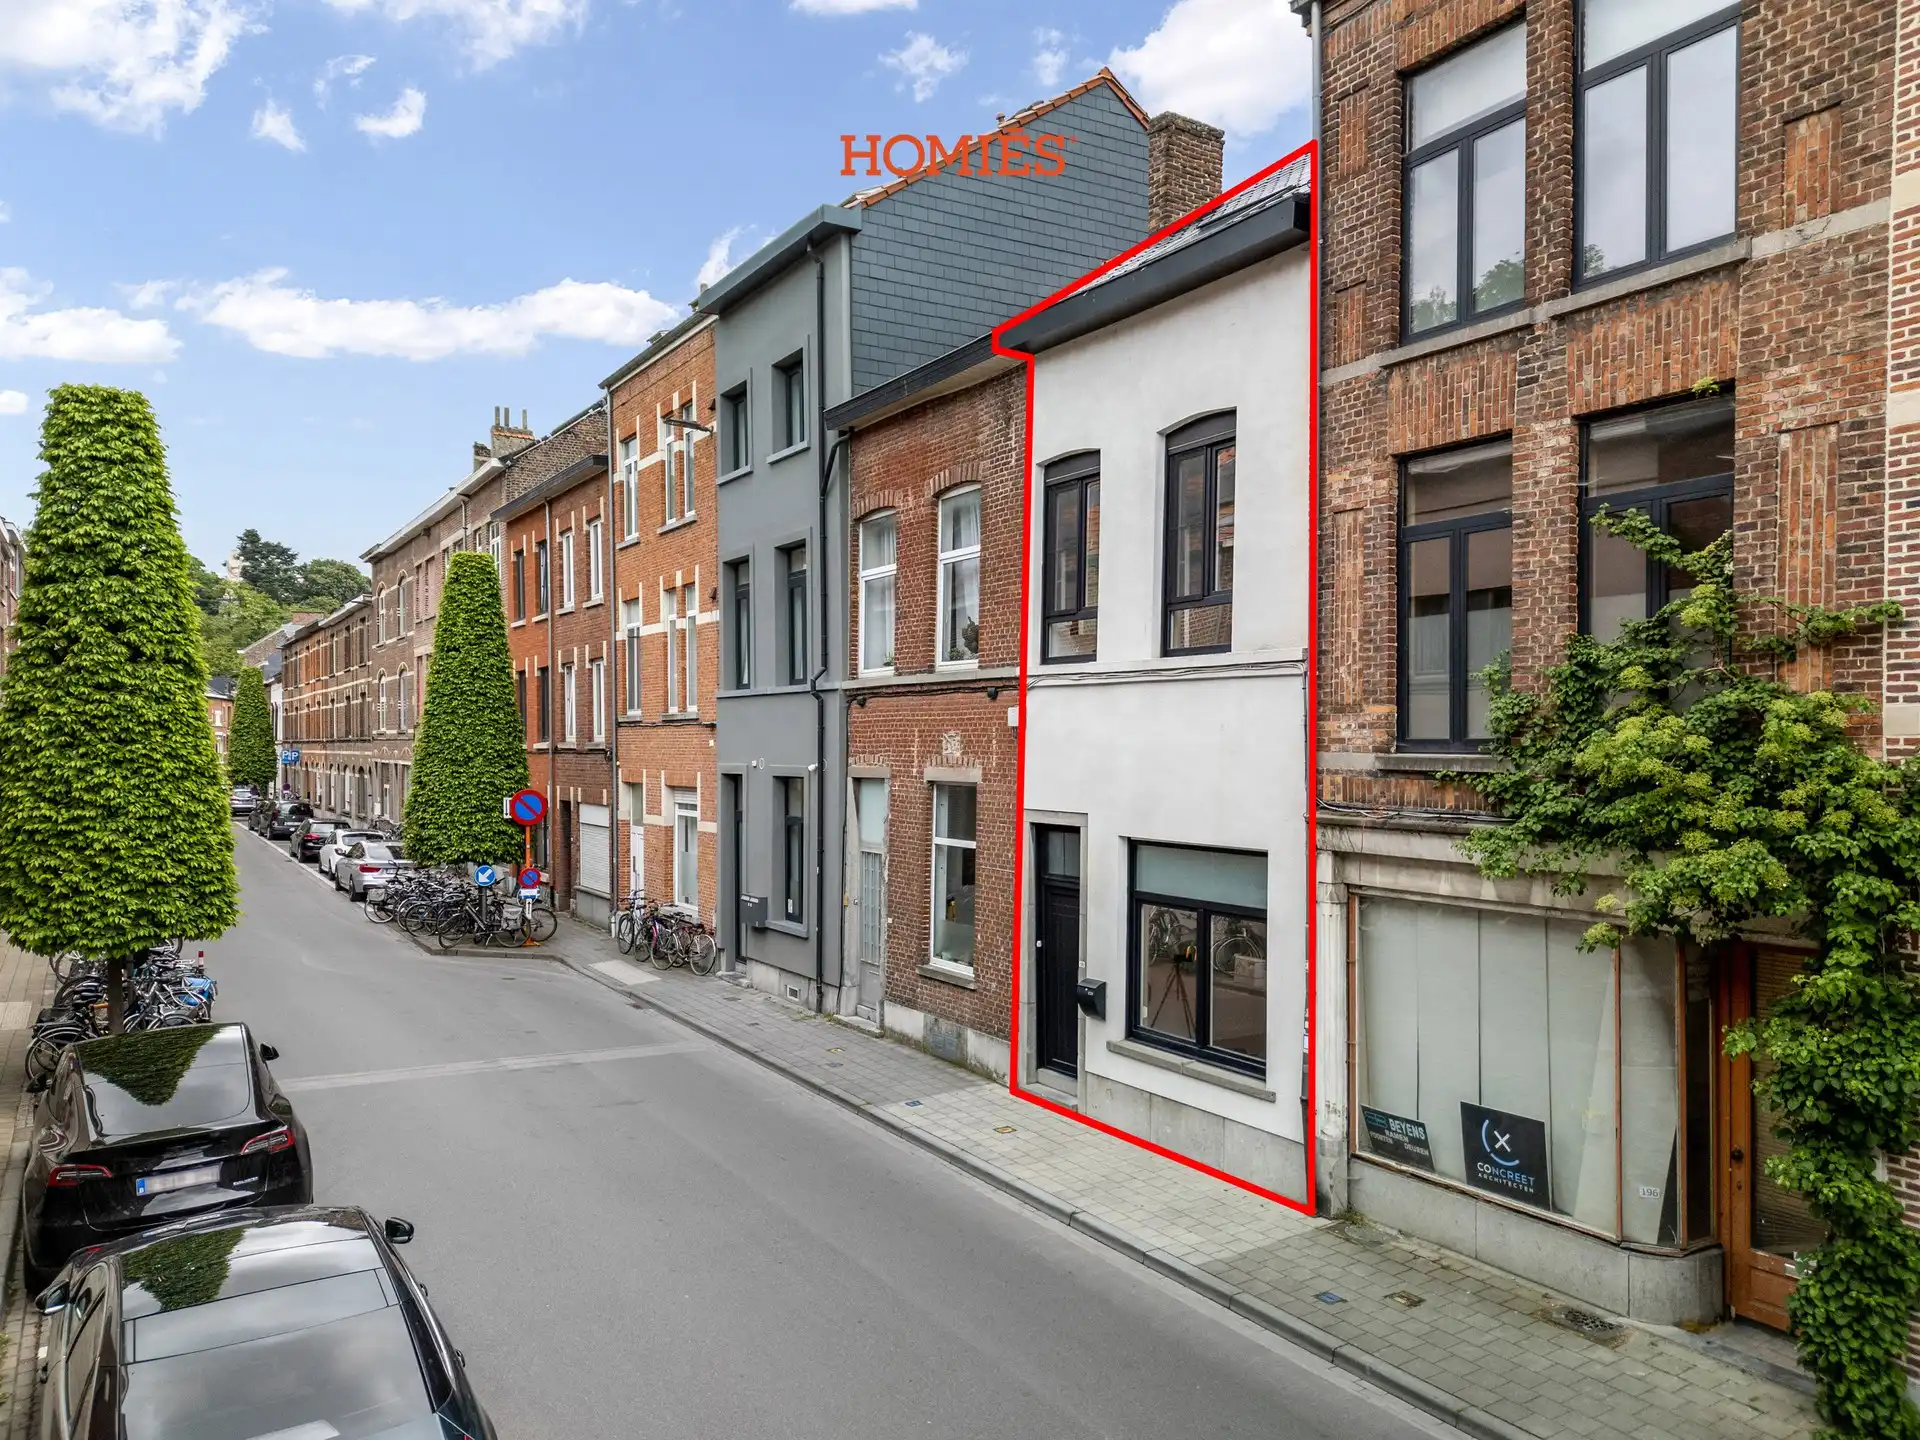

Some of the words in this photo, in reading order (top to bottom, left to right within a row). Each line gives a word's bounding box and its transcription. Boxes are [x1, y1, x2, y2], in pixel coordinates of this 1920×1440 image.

[1384, 1129, 1409, 1143] RAMEN
[1388, 1117, 1426, 1140] BEYENS
[1476, 1161, 1535, 1187] CONCREET
[1477, 1172, 1535, 1194] ARCHITECTEN
[1642, 1188, 1659, 1197] 196
